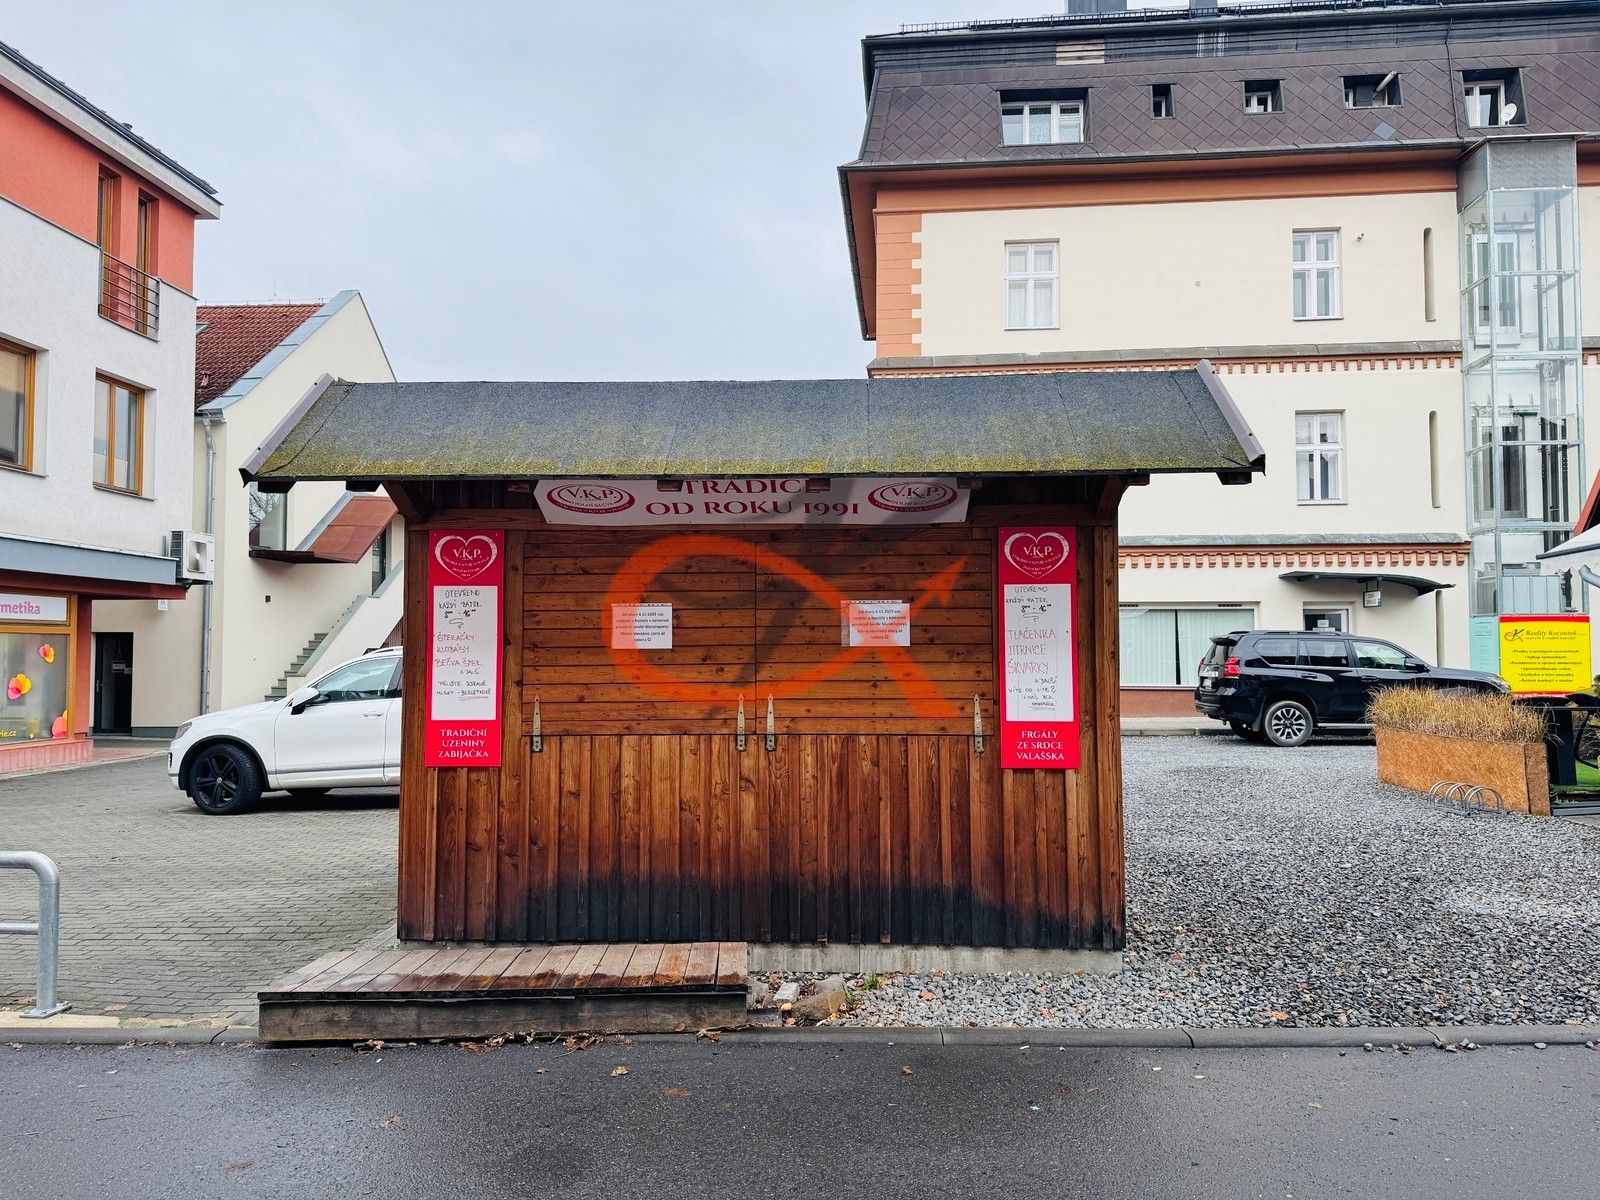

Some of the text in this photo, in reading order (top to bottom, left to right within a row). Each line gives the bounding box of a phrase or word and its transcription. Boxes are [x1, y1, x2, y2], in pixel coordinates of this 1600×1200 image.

[645, 502, 694, 515] OD
[704, 501, 792, 514] ROKU
[803, 502, 859, 516] 1991
[0, 601, 41, 615] metika
[440, 727, 488, 737] TRADIČNÍ
[1021, 729, 1059, 739] FRGÁLY
[442, 739, 485, 748] UZENINY
[1030, 741, 1064, 749] SRDCE
[438, 750, 489, 759] ZABIJAČKA
[1016, 751, 1065, 760] VALAŠSKA
